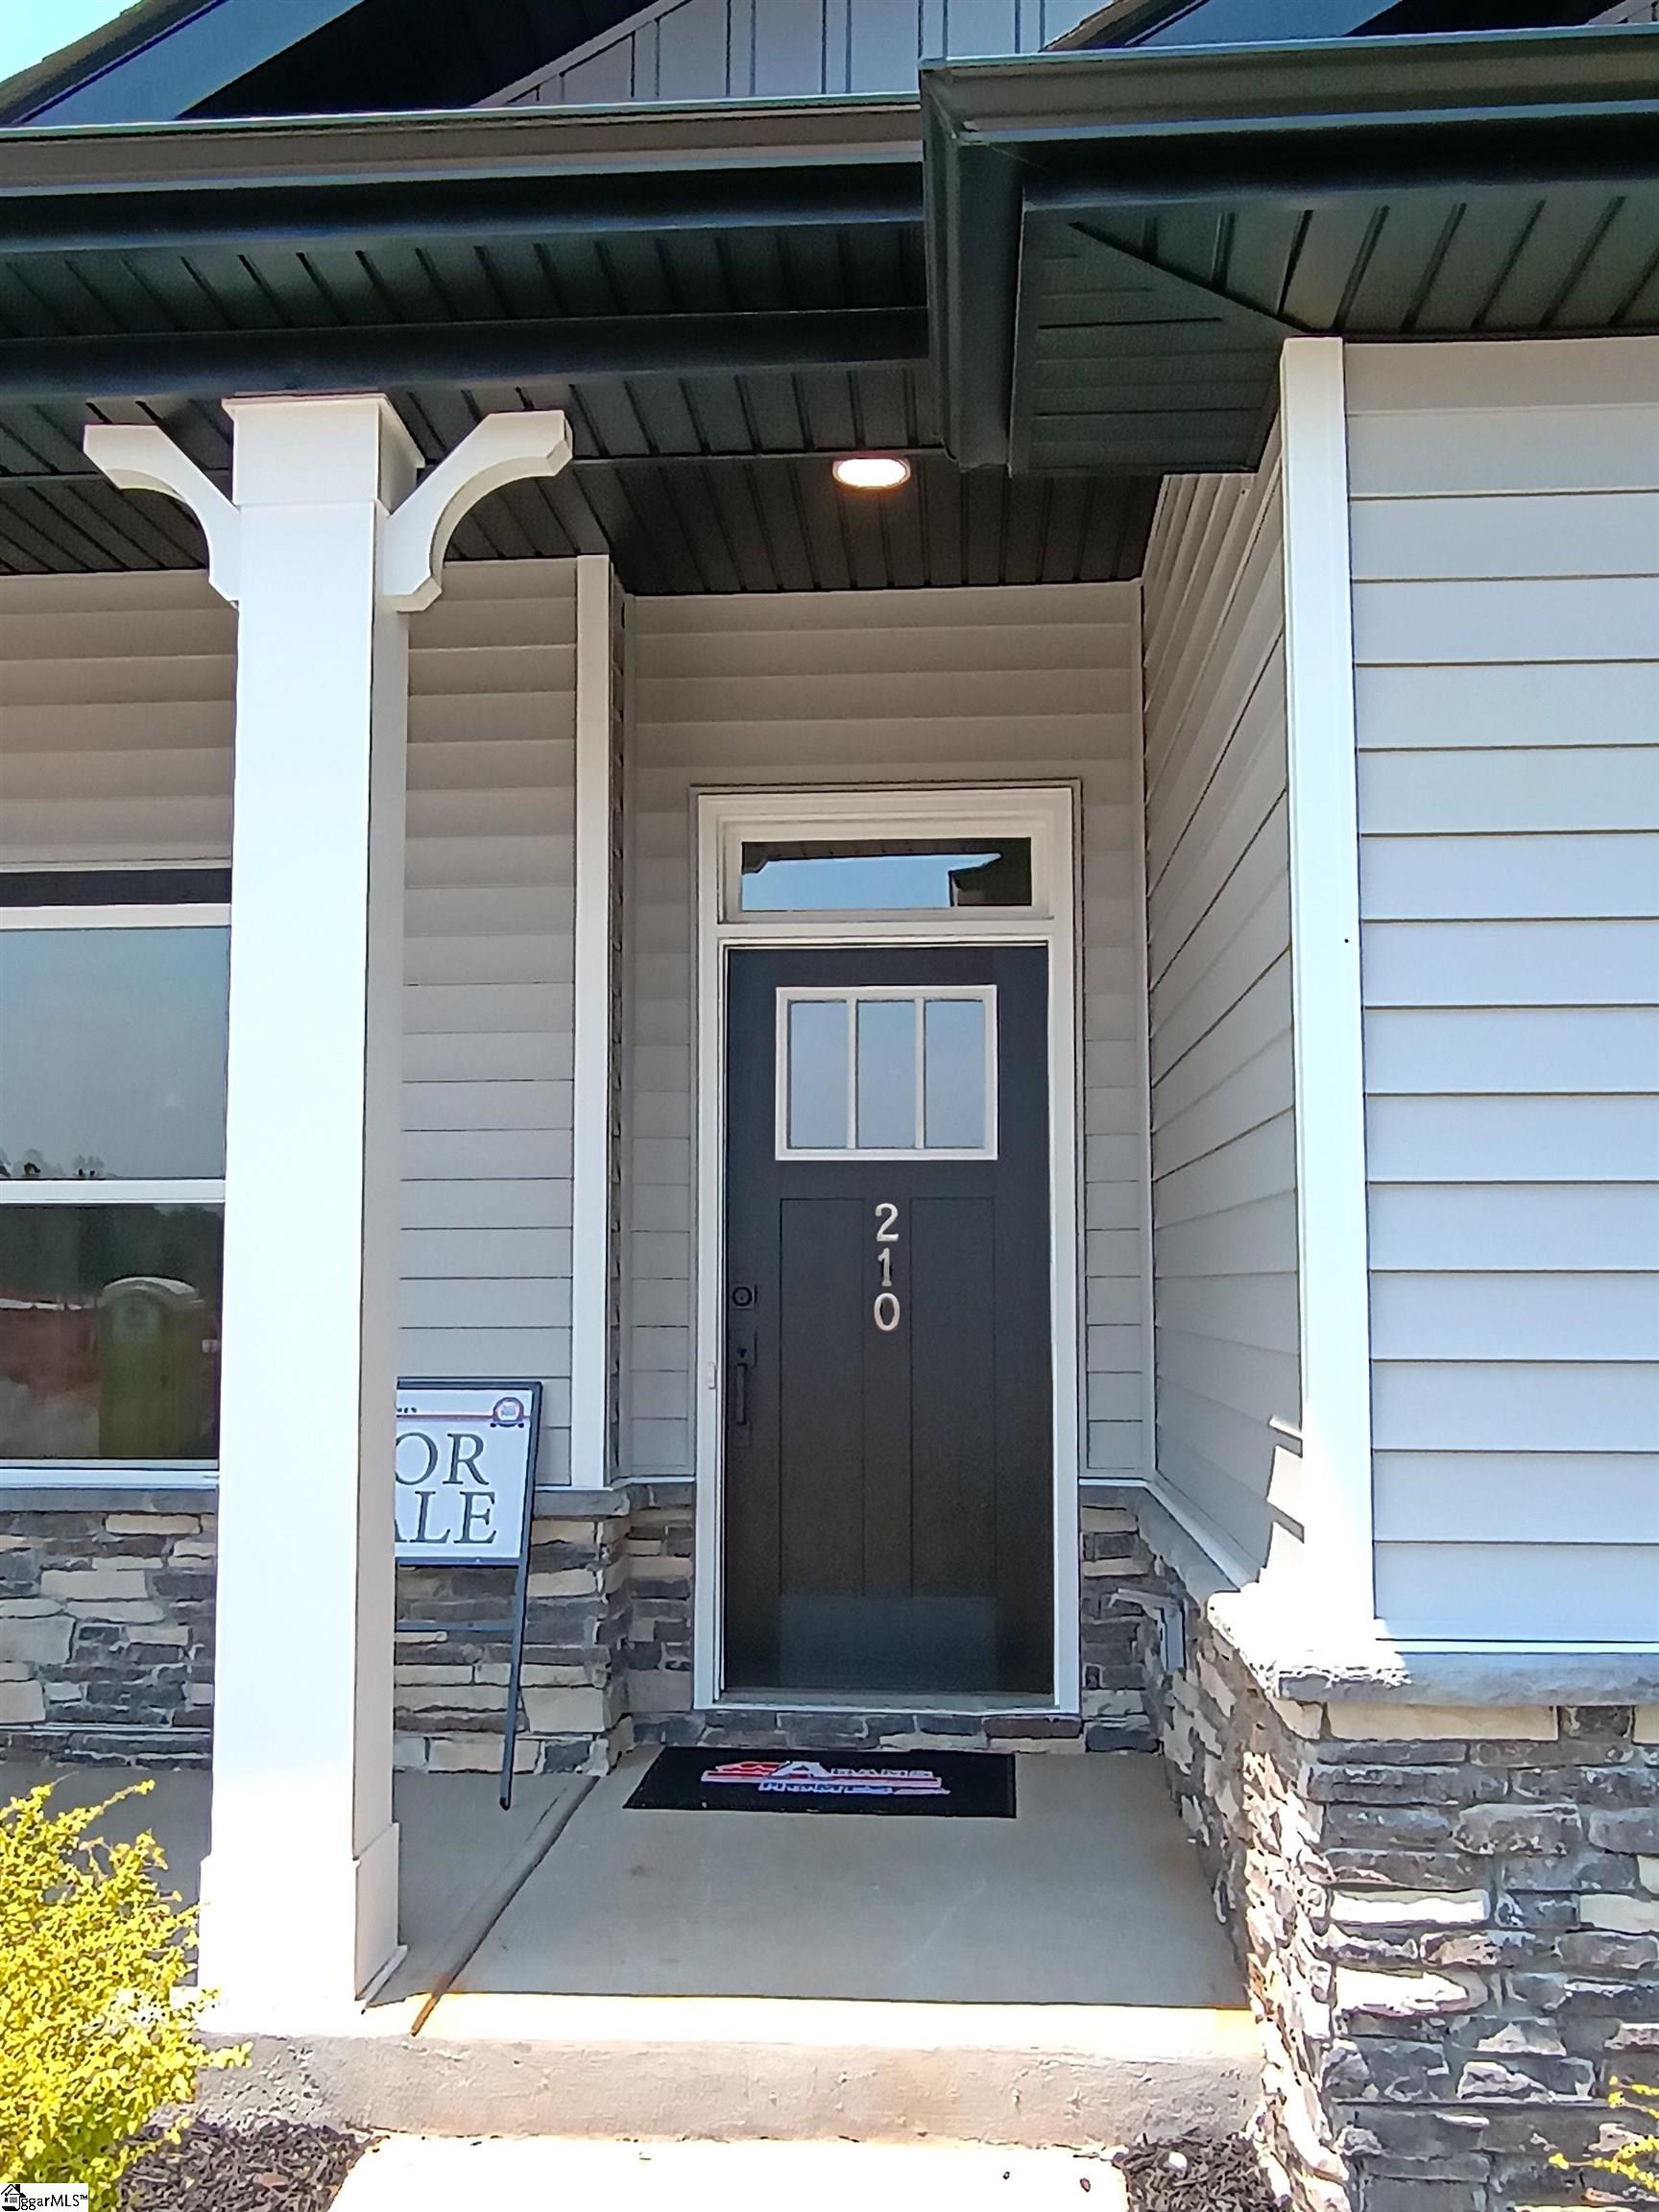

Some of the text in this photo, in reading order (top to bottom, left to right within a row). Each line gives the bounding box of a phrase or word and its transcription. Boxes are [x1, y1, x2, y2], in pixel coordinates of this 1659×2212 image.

[874, 1203, 901, 1332] 210
[395, 1431, 490, 1486] OR
[395, 1490, 496, 1544] LE
